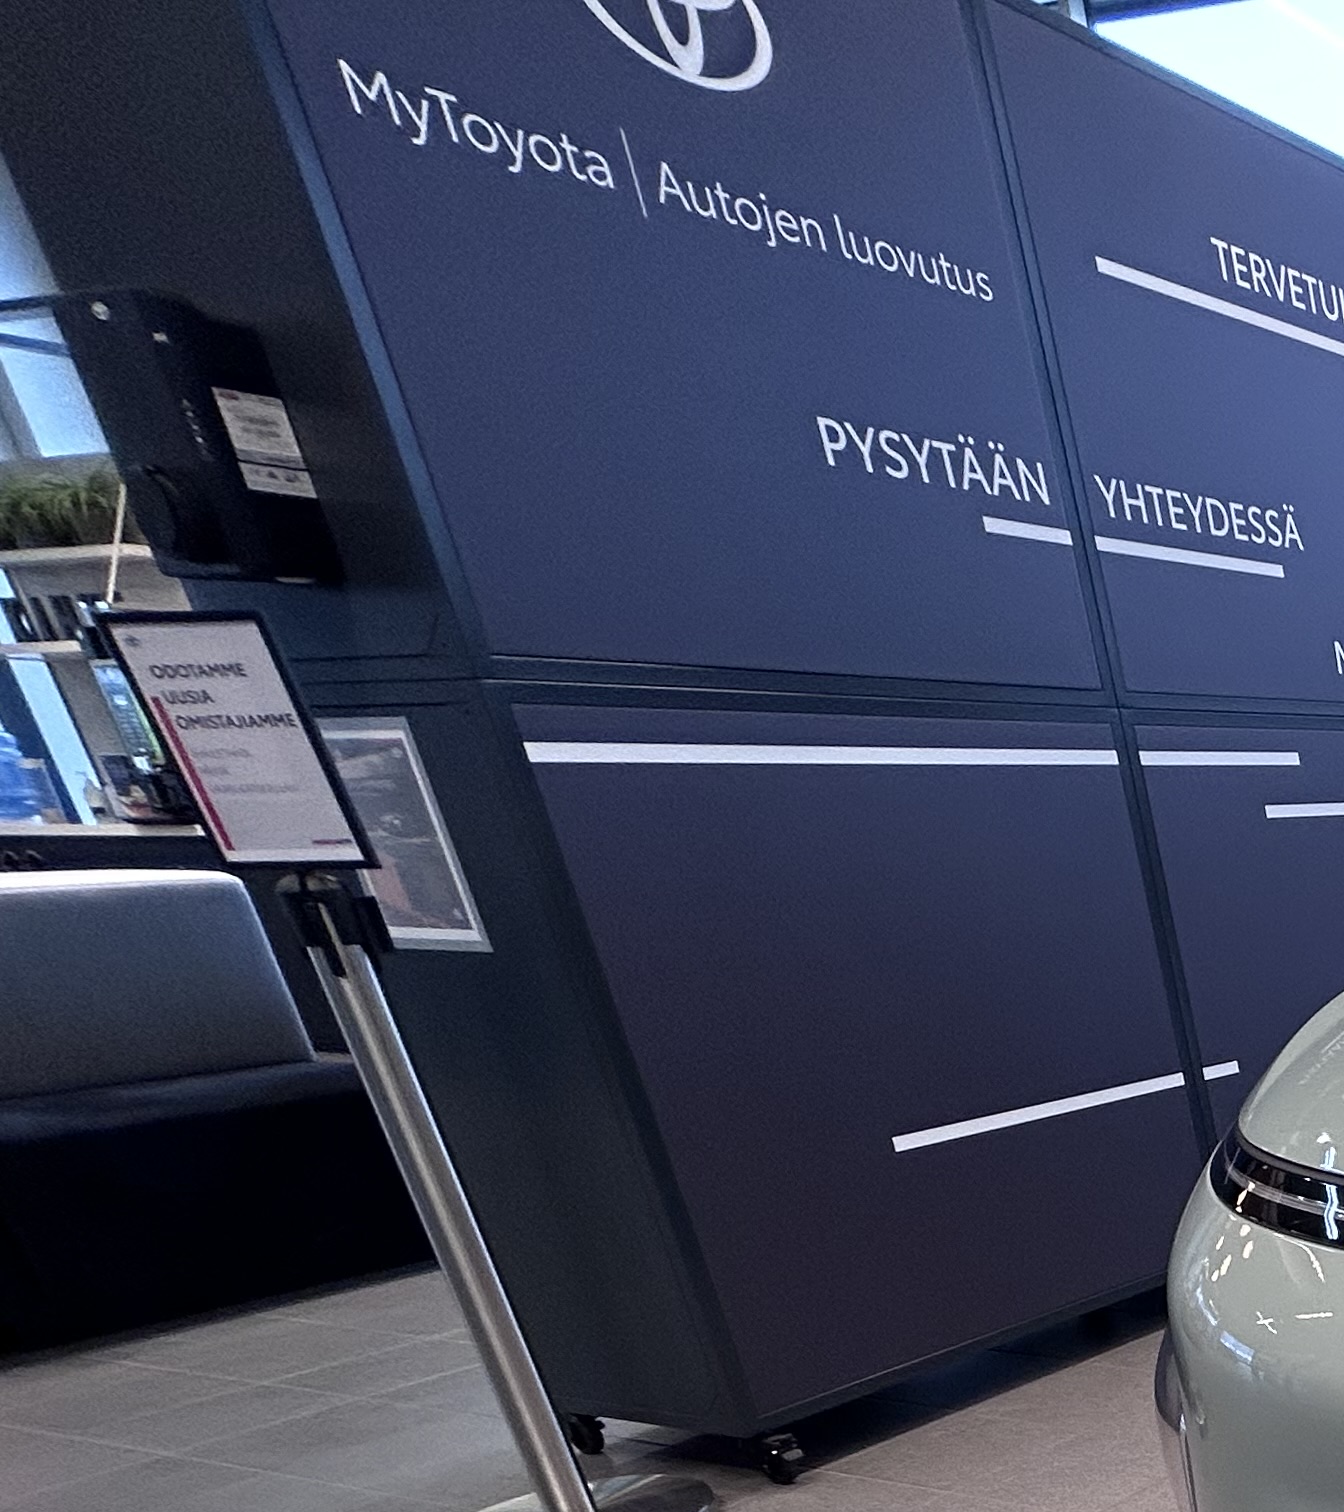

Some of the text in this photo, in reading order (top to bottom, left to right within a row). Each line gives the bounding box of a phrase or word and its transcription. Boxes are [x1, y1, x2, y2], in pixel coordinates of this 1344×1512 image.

[337, 58, 994, 302] MyToyota Autojen luovutus
[816, 416, 1305, 551] PYSYTÄÄN YHTEYDESSÄ
[150, 663, 247, 679] ODOTAMME
[163, 690, 215, 704] UUSIA
[176, 714, 298, 730] OMISTAJIAMME
